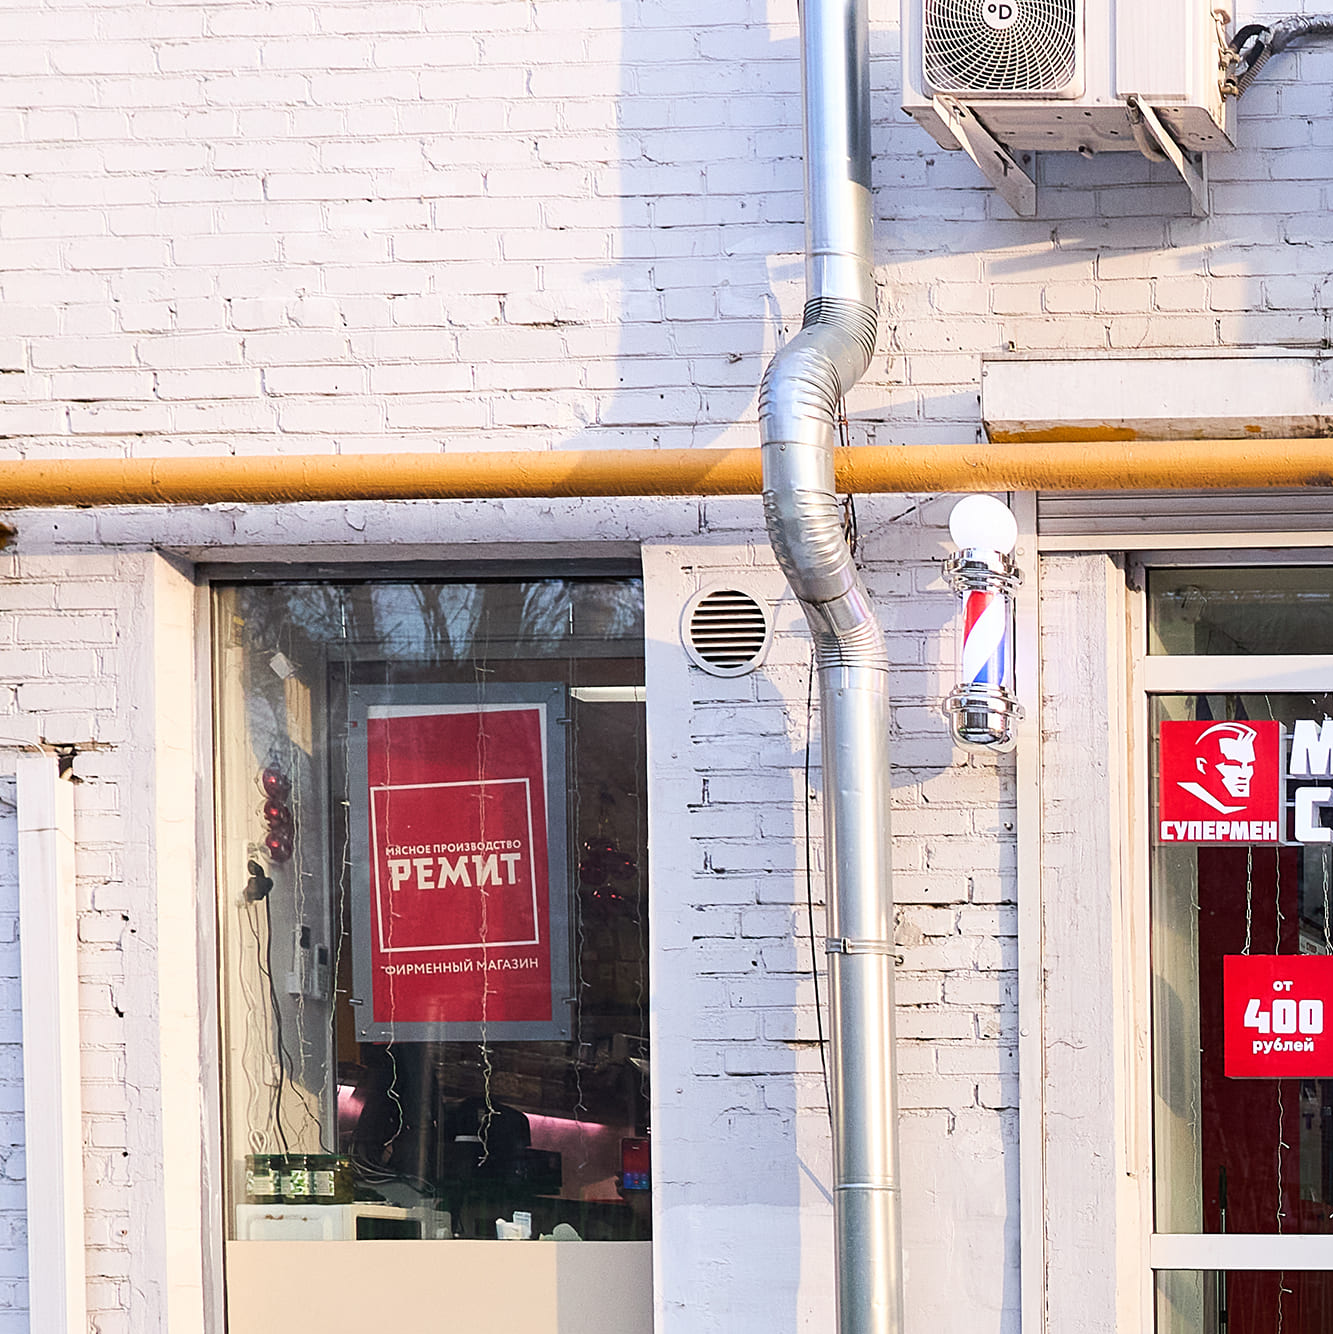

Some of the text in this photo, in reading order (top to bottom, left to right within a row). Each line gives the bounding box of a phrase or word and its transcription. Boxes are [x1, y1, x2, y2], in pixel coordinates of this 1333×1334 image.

[1160, 820, 1278, 841] СУПЕРМЕН
[385, 840, 522, 856] МЯСНОЕ ПРОИЗВОДСТВО
[387, 853, 521, 892] РЕМИТ
[385, 958, 539, 975] ФИРМЕННЫЙ МАГАЗИН
[1272, 979, 1293, 992] от
[1243, 999, 1323, 1034] 400
[1252, 1037, 1315, 1054] рублей
